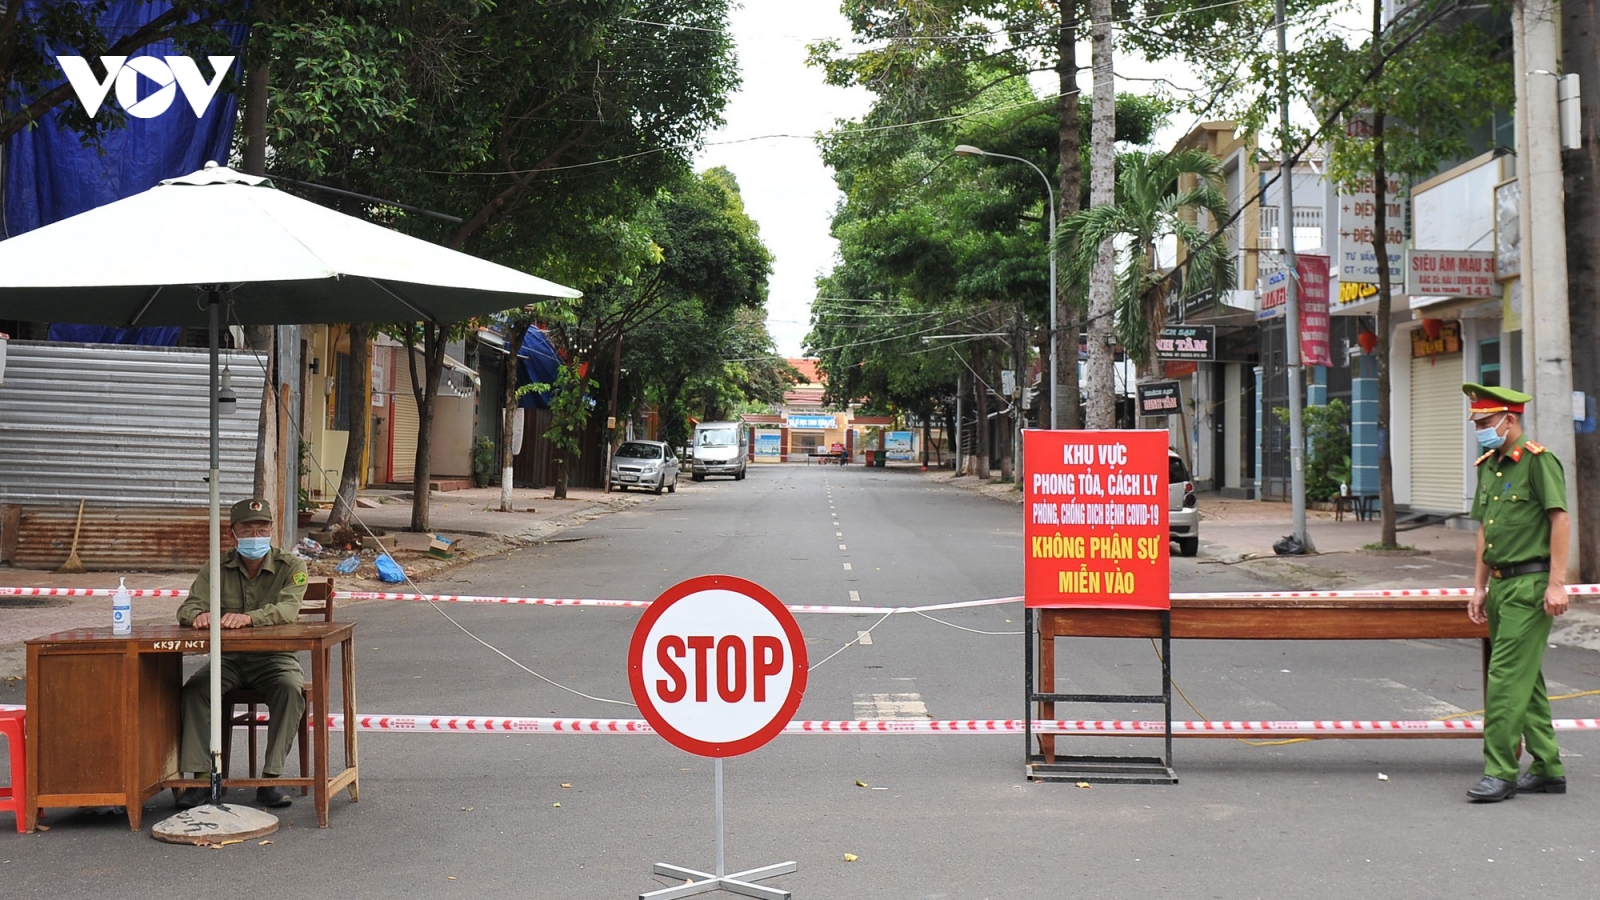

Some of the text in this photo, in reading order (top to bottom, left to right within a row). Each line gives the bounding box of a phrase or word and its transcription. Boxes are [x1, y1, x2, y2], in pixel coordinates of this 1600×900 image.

[1344, 265, 1355, 274] CT
[1412, 254, 1436, 271] SIÊU
[1439, 255, 1455, 272] ÂM
[1459, 255, 1482, 272] MÀU
[1466, 286, 1491, 296] 141
[1175, 337, 1208, 351] TÂM
[1063, 442, 1127, 469] KHU VỰC
[1033, 468, 1158, 498] PHONG TỎA, CÁCH LY
[1033, 497, 1159, 529] PHÒNG, CHỐNG DỊCH BỆNH COVID-19
[1032, 532, 1161, 564] KHÔNG PHẬN SỰ
[1059, 564, 1135, 594] MIỄN VÀO
[153, 640, 205, 650] KK97 NCT
[656, 635, 784, 703] STOP
